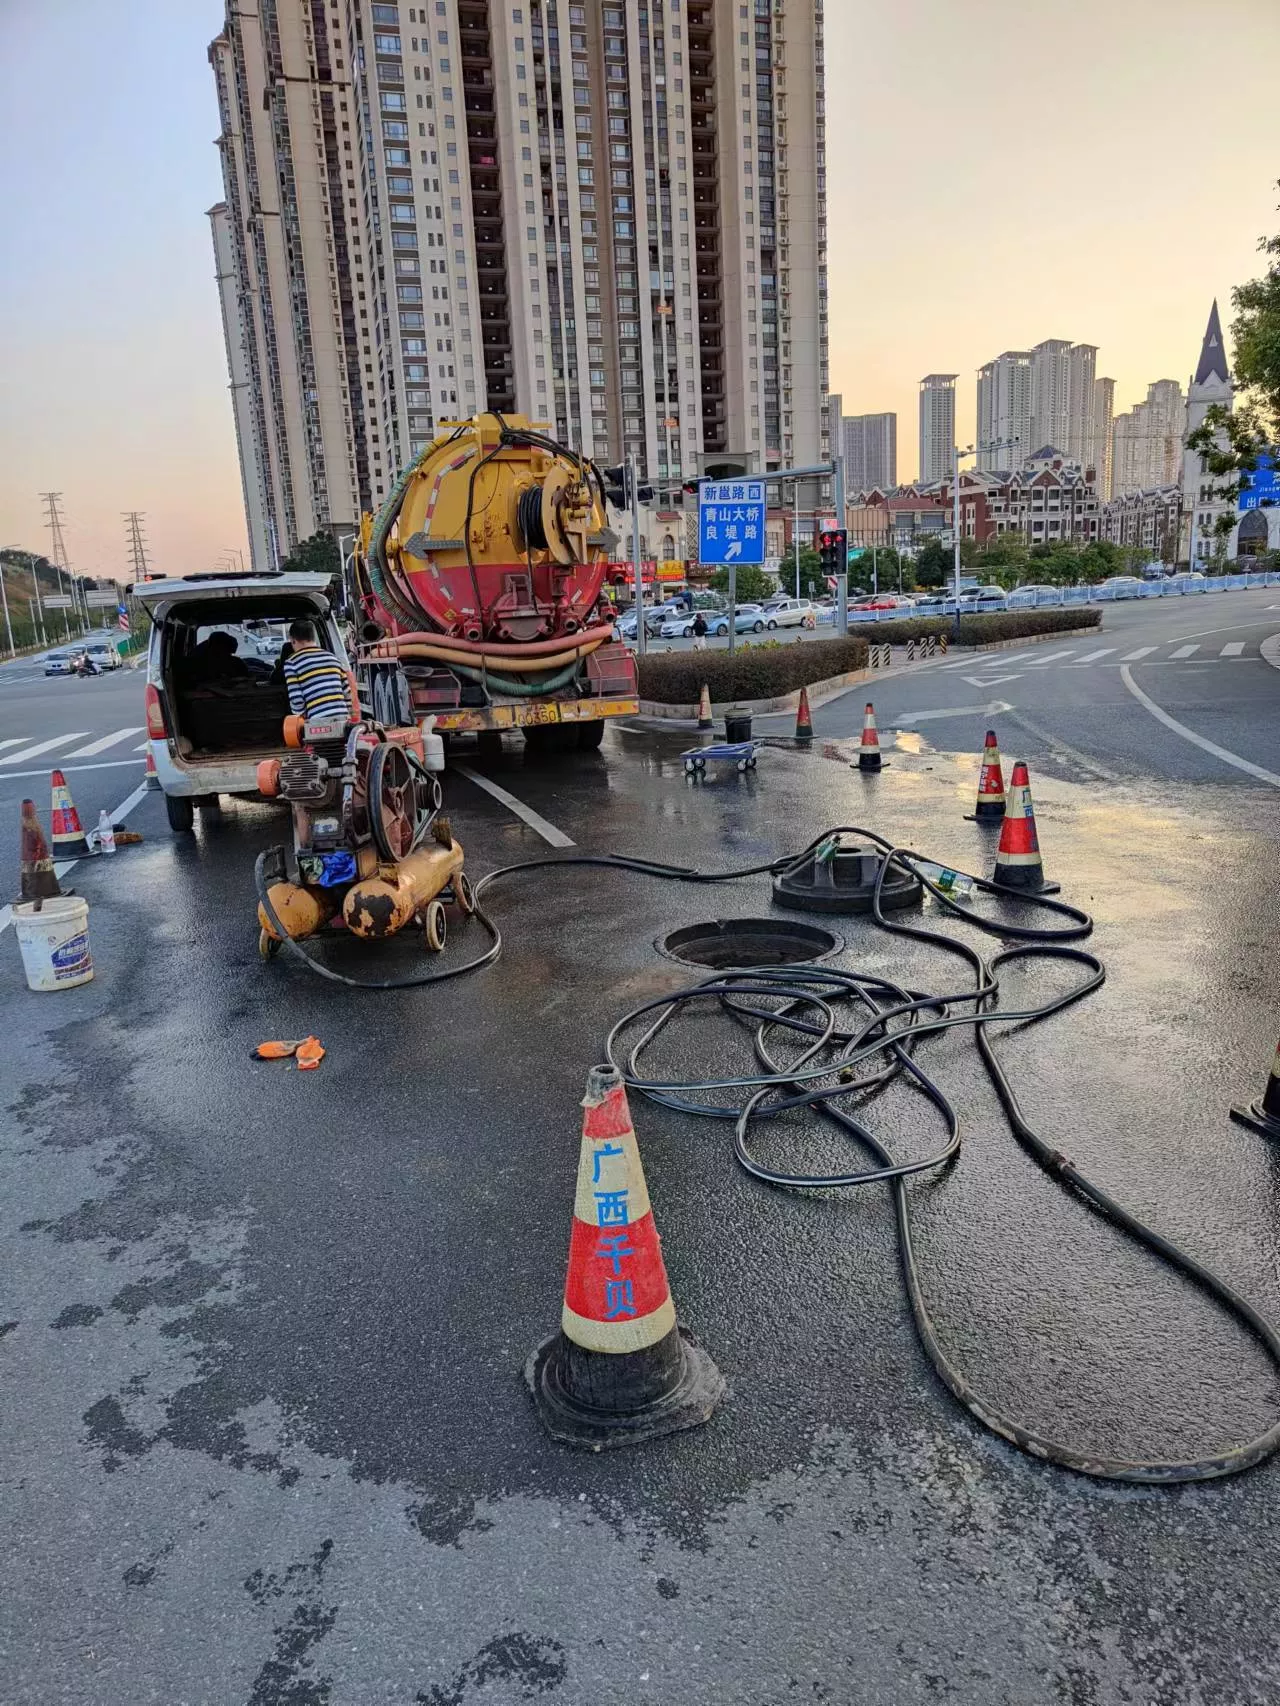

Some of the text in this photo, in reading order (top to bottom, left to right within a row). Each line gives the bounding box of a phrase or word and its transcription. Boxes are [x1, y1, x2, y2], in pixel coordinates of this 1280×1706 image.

[704, 485, 761, 500] 新邕路 西
[705, 507, 760, 522] 青山大桥
[706, 525, 758, 540] 良堤路
[592, 1143, 636, 1319] 广西千贝
